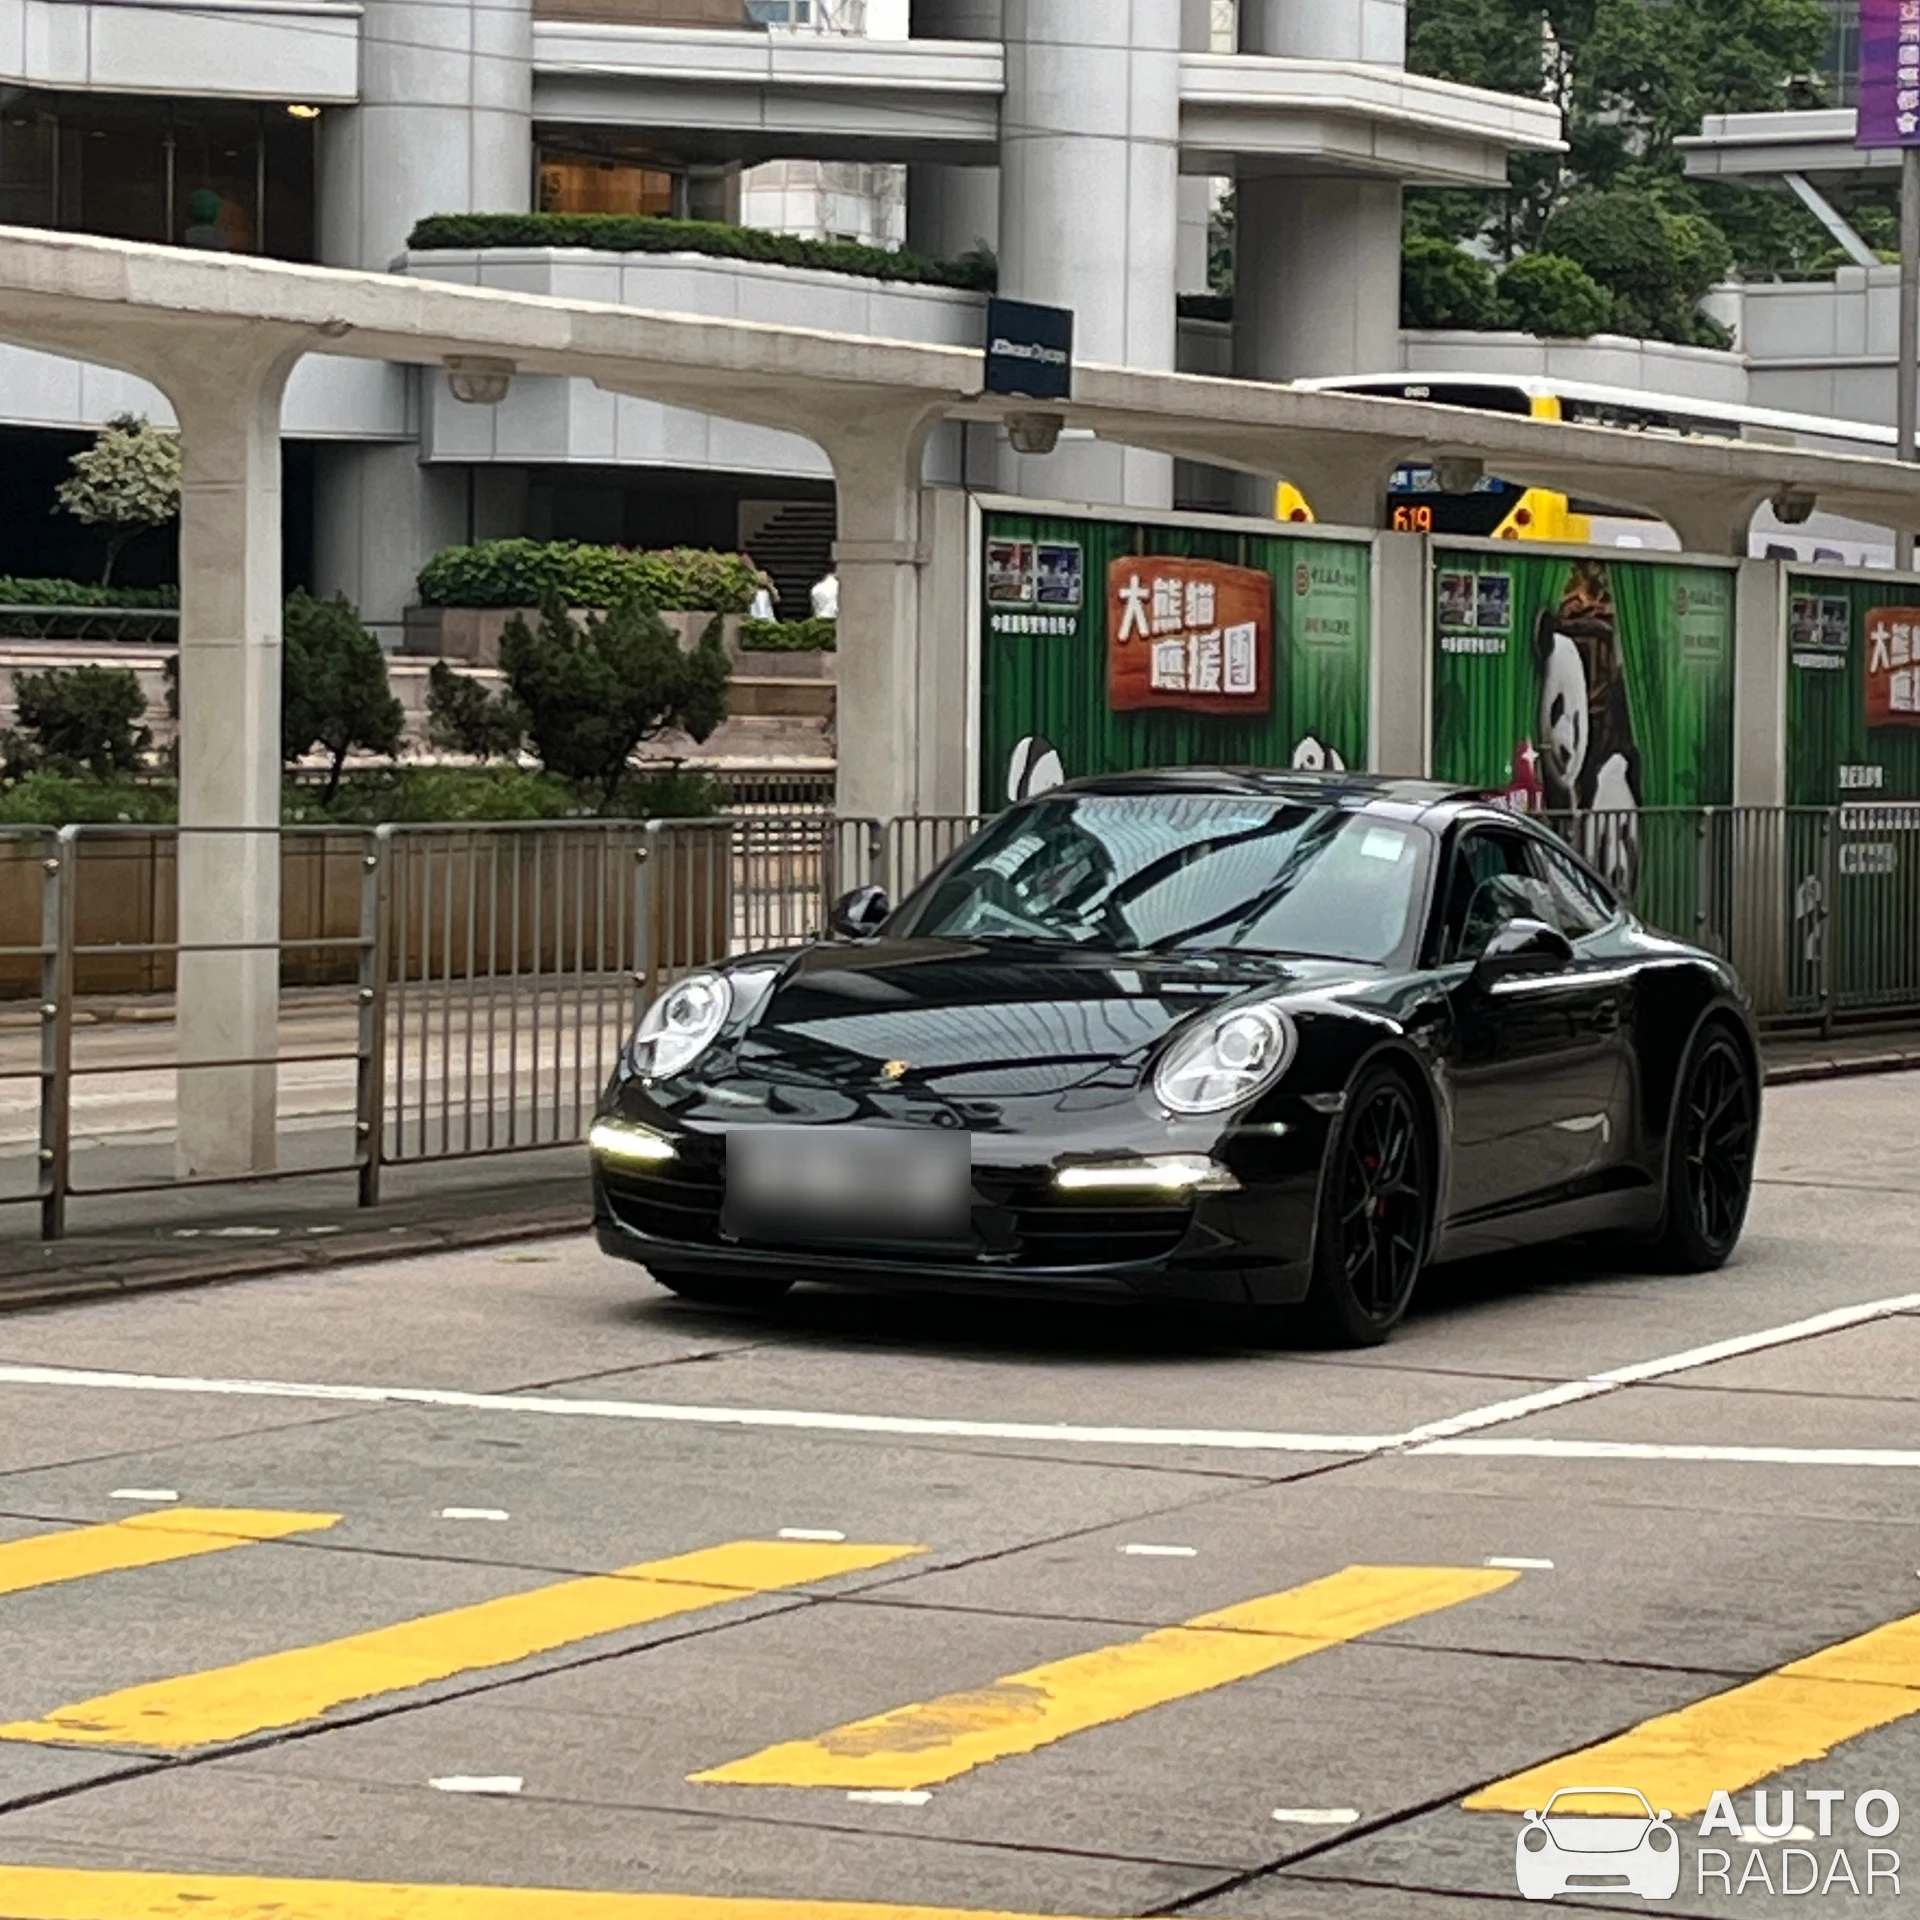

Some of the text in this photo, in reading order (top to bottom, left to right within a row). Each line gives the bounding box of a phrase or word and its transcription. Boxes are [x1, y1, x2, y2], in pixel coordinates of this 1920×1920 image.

[1393, 505, 1432, 532] 619
[1117, 574, 1216, 642] 大熊貓
[1150, 621, 1257, 693] 應援團
